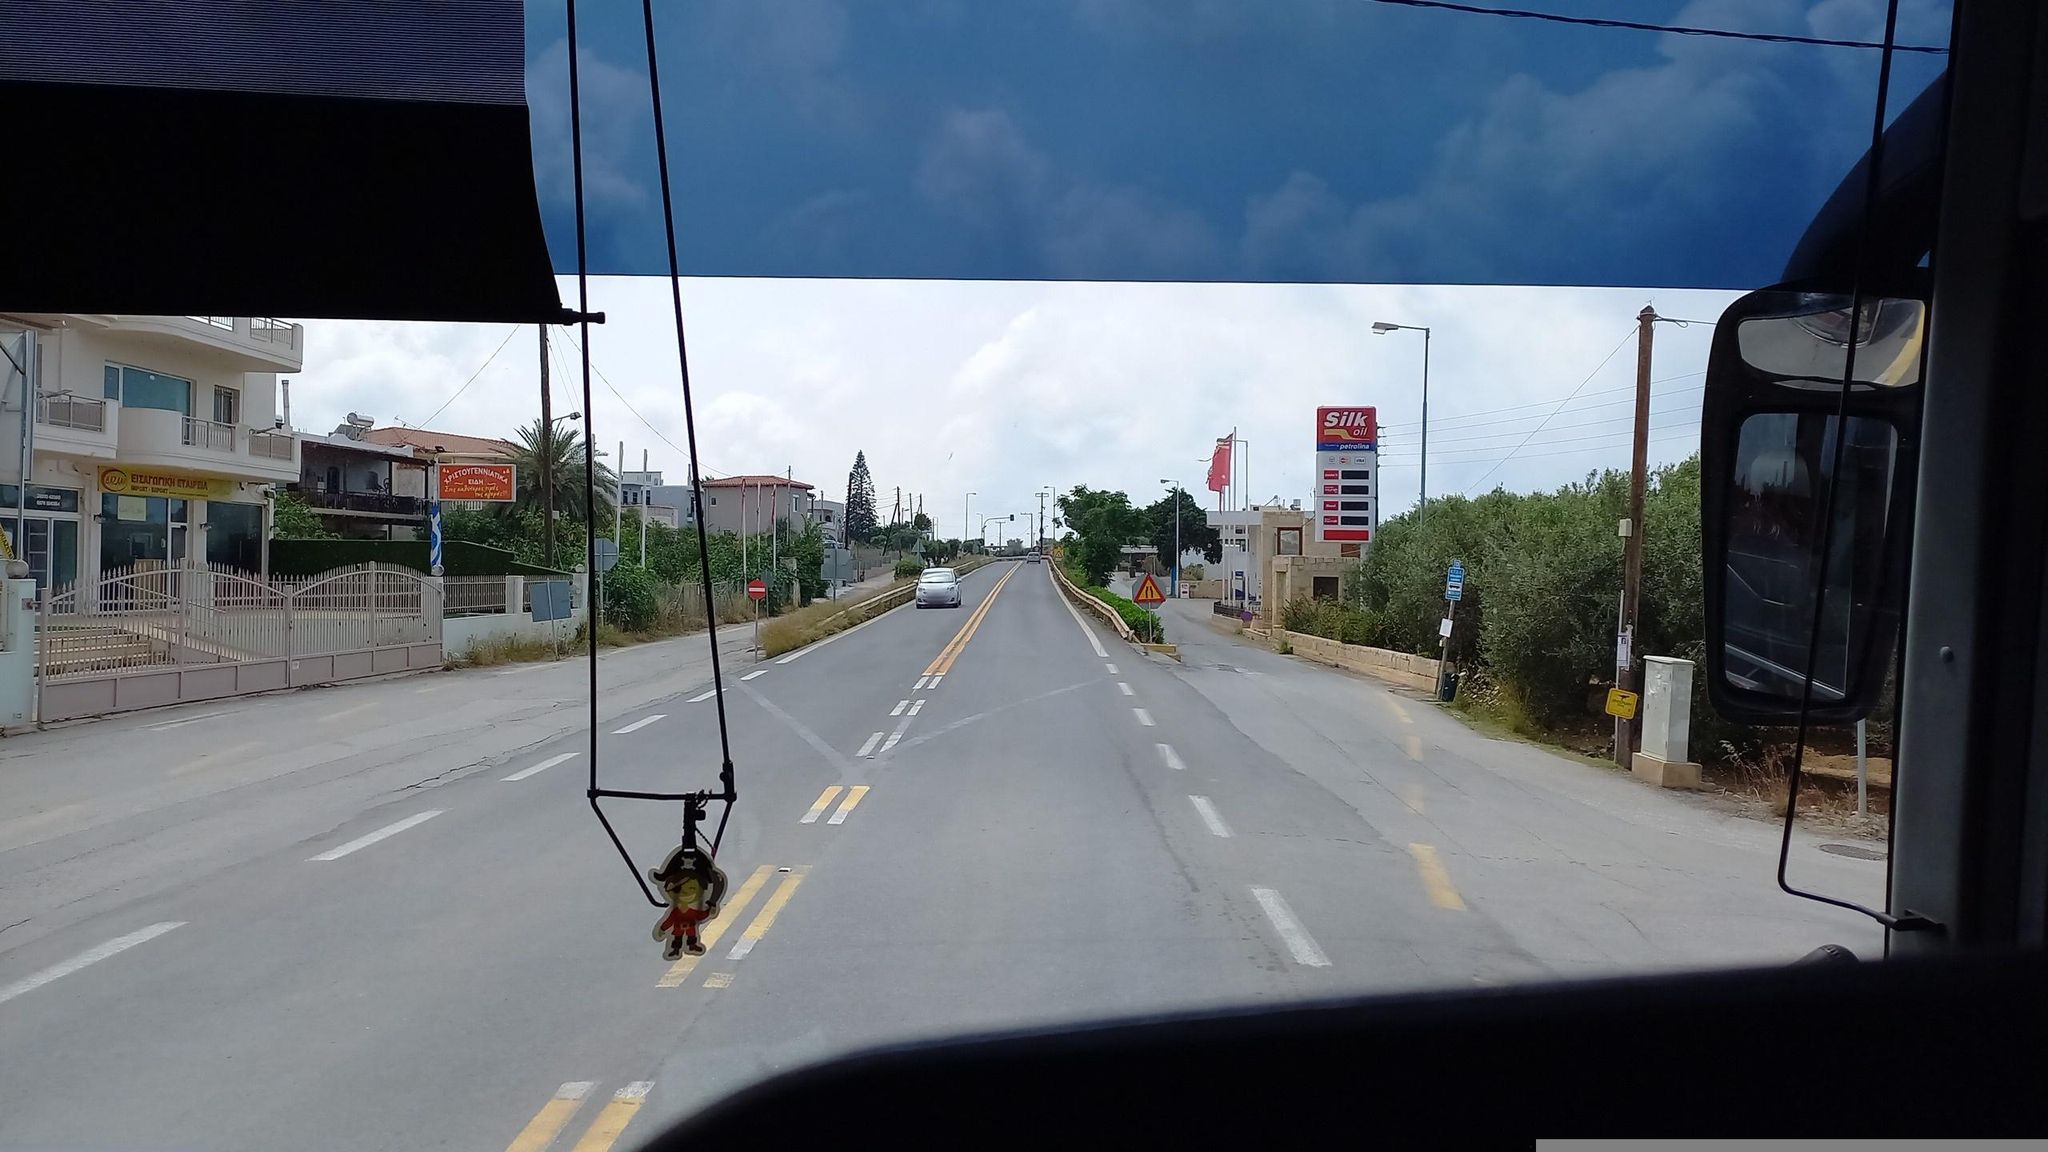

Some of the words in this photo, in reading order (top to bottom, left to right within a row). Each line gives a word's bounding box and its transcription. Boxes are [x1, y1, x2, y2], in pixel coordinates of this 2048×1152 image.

[1324, 411, 1368, 427] Silk
[1353, 427, 1368, 436] oil
[444, 467, 508, 484] ΧΡΙΣΤΟΥΓΕΝΝΙΑΤΙΚΑ
